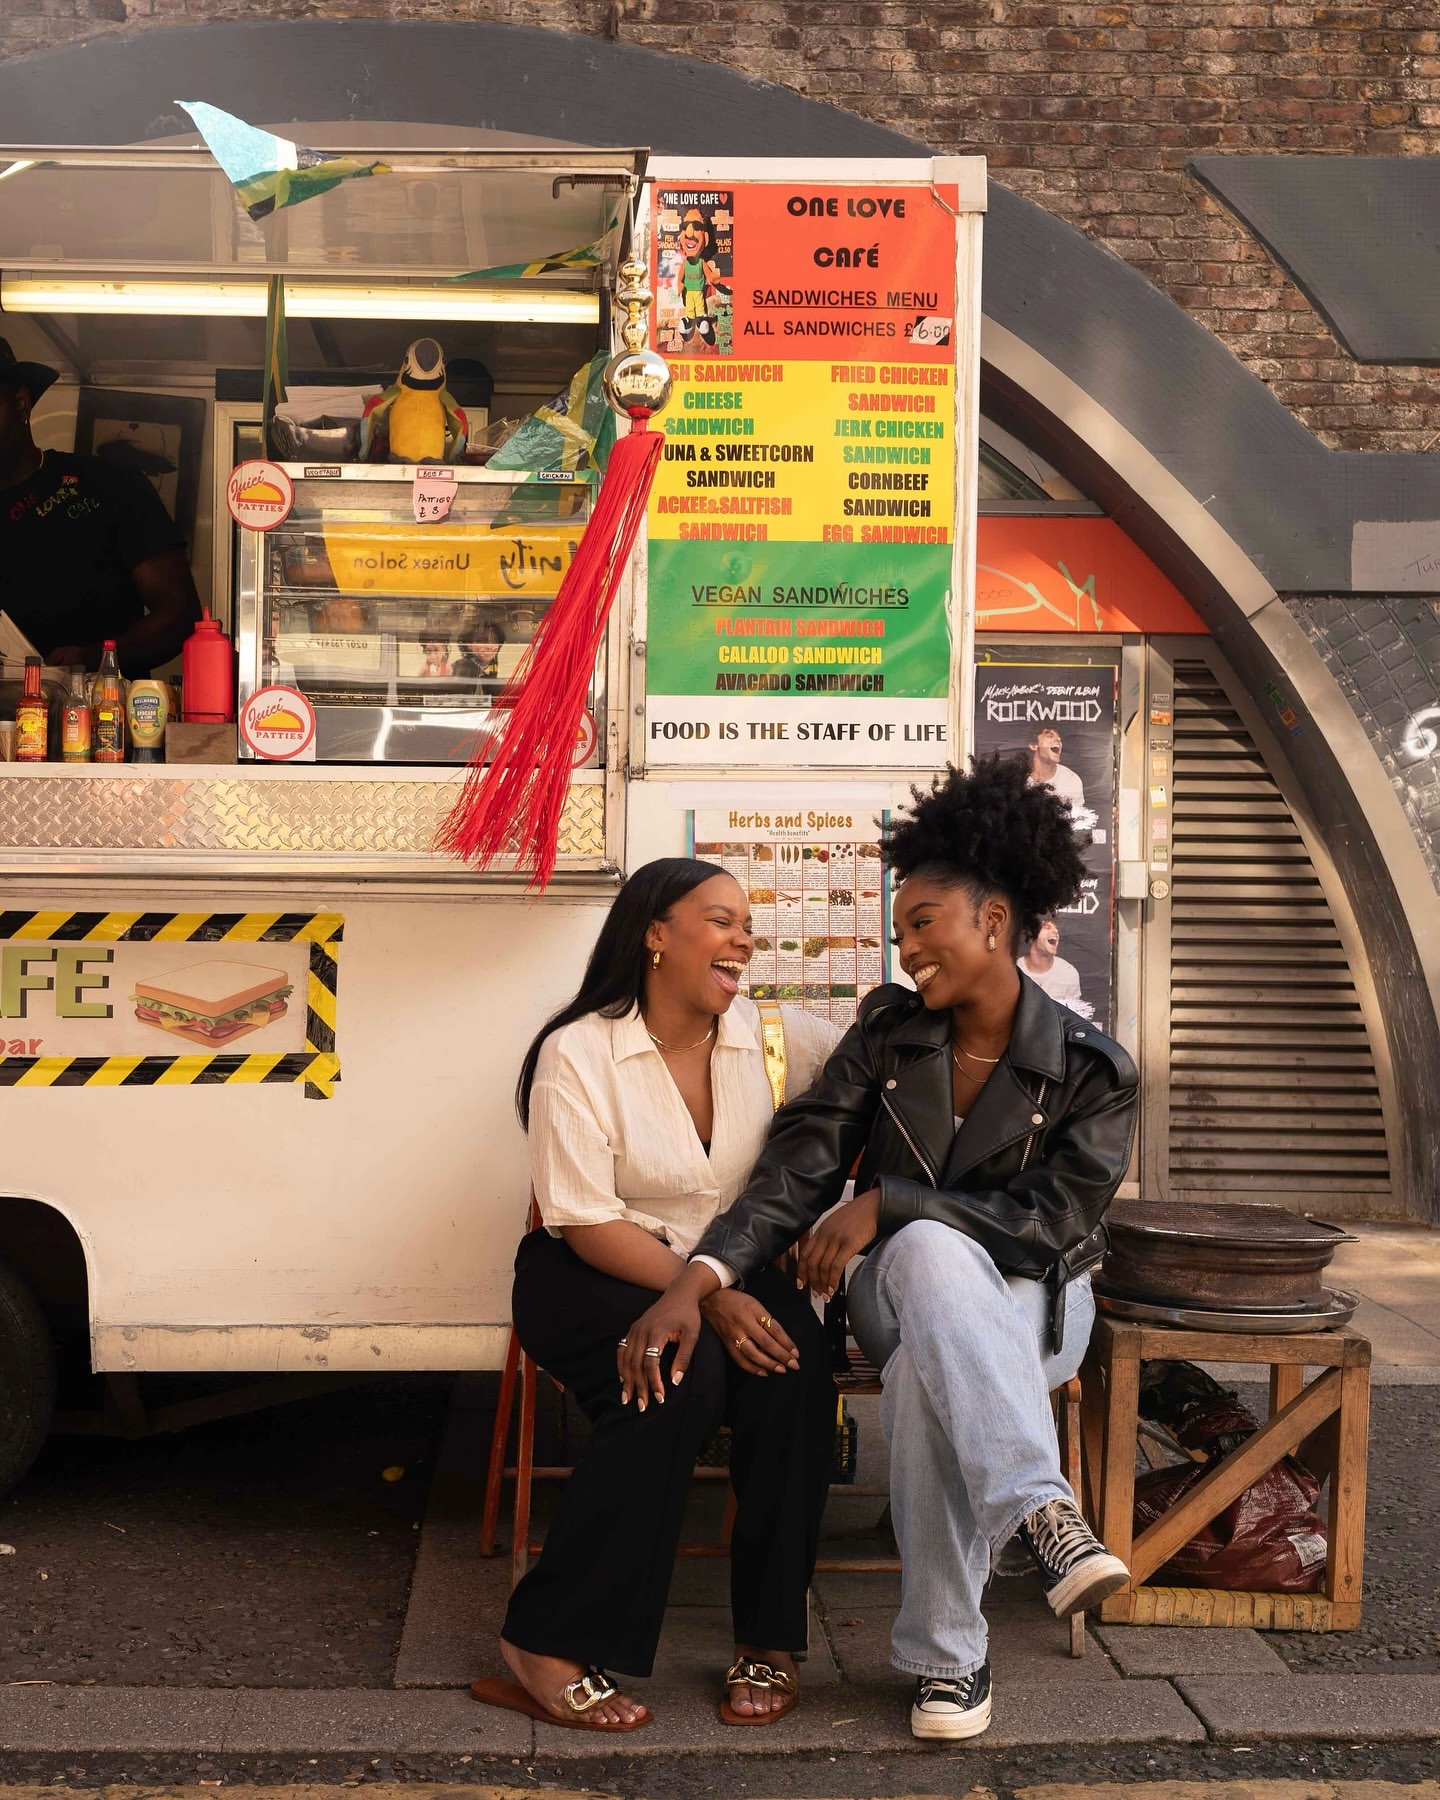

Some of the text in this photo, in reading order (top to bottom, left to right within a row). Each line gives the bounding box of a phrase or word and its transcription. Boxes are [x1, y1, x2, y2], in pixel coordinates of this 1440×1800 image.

[663, 192, 719, 205] ONE LOVE CAFE
[786, 196, 906, 219] ONE LOVE
[813, 243, 880, 268] CAFÉ
[752, 289, 938, 308] SANDWICHES MENU
[743, 320, 775, 336] ALL
[783, 320, 896, 337] SANDWICHES
[670, 364, 784, 382] SH SANDWICH
[831, 365, 948, 385] FRIED CHICKEN
[683, 391, 743, 409] CHEESE
[848, 393, 935, 412] SANDWICH
[665, 418, 754, 435] SANDWICH
[833, 419, 944, 439] JERK CHICKEN
[660, 444, 814, 463] UNA & SWEETCORN
[843, 445, 931, 464] SANDWICH
[686, 470, 775, 488] SANDWICH
[848, 472, 929, 490] CORNBEEF
[237, 503, 284, 512] PATTIES
[657, 496, 792, 515] ACKEE&SALTFISH
[843, 498, 931, 517] SANDWICH
[679, 522, 768, 541] SANDWICH
[823, 524, 948, 544] EGG SANDWICH
[691, 585, 909, 606] VEGAN SANDWICHES
[715, 618, 885, 637] PLANTAIN SANDWICH
[718, 646, 882, 665] CALALOO SANDWICH
[715, 673, 884, 692] AVACADO SANDWICH
[987, 699, 1102, 722] ROCKWOOD
[256, 732, 304, 740] PATTIES
[650, 722, 947, 742] FOOD IS THE STAFF OF LIFE
[728, 811, 853, 831] Herbs and Spices
[0, 946, 114, 1018] FE
